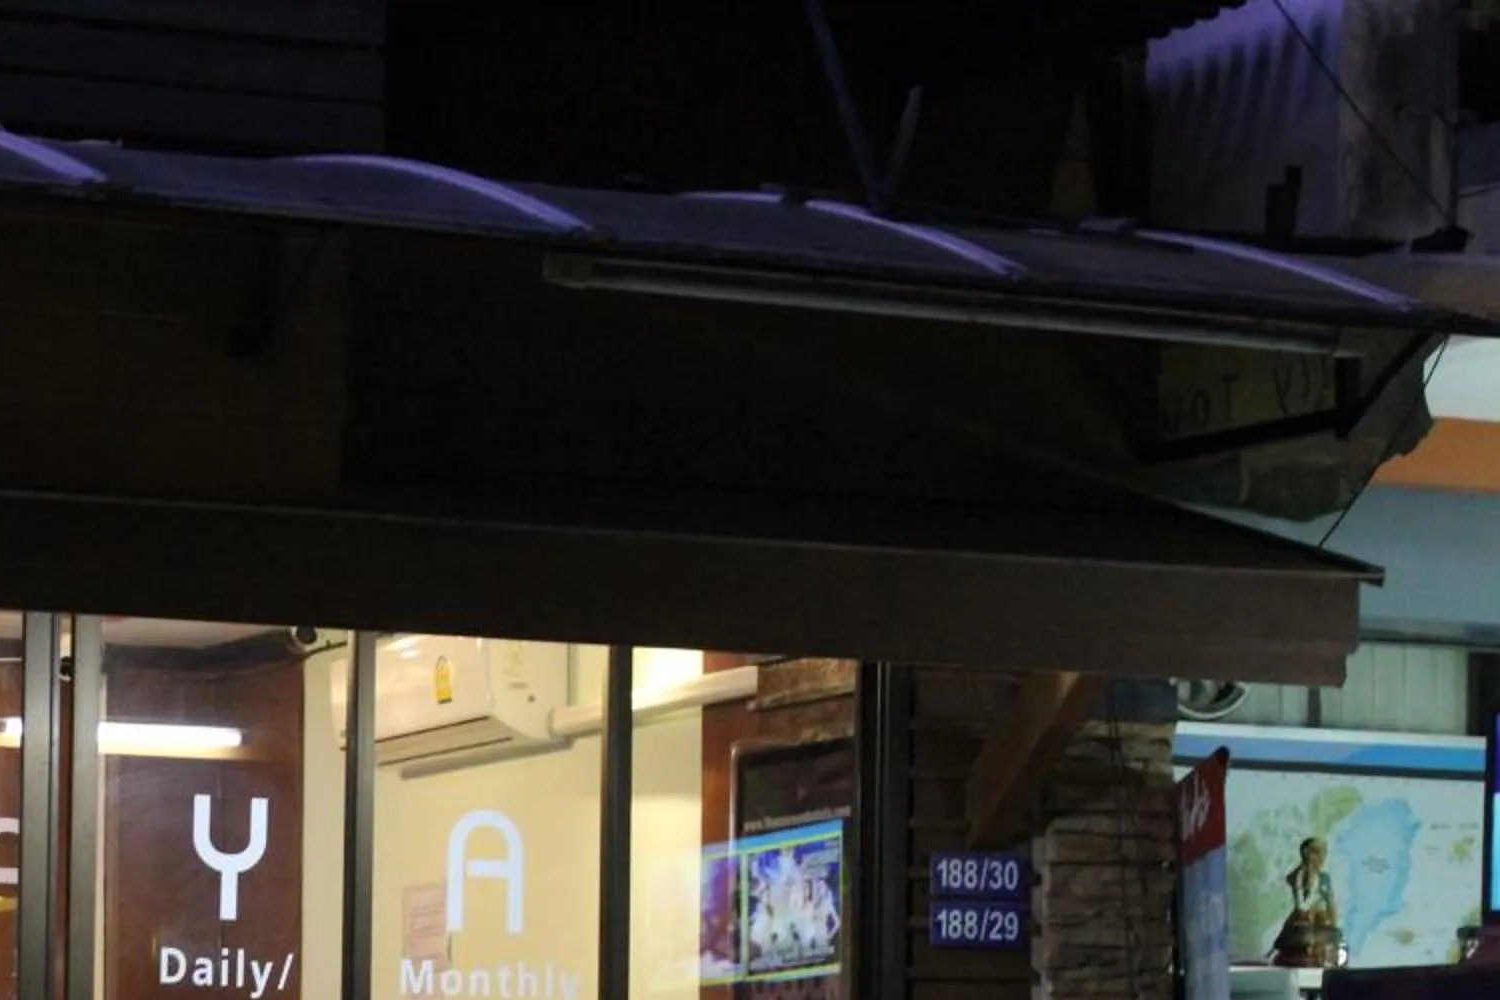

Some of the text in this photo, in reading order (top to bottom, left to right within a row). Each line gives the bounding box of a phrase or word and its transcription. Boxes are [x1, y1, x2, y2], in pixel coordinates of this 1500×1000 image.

[936, 857, 1019, 891] 188/30
[936, 909, 1019, 943] 188/29
[160, 947, 294, 1000] Daily/
